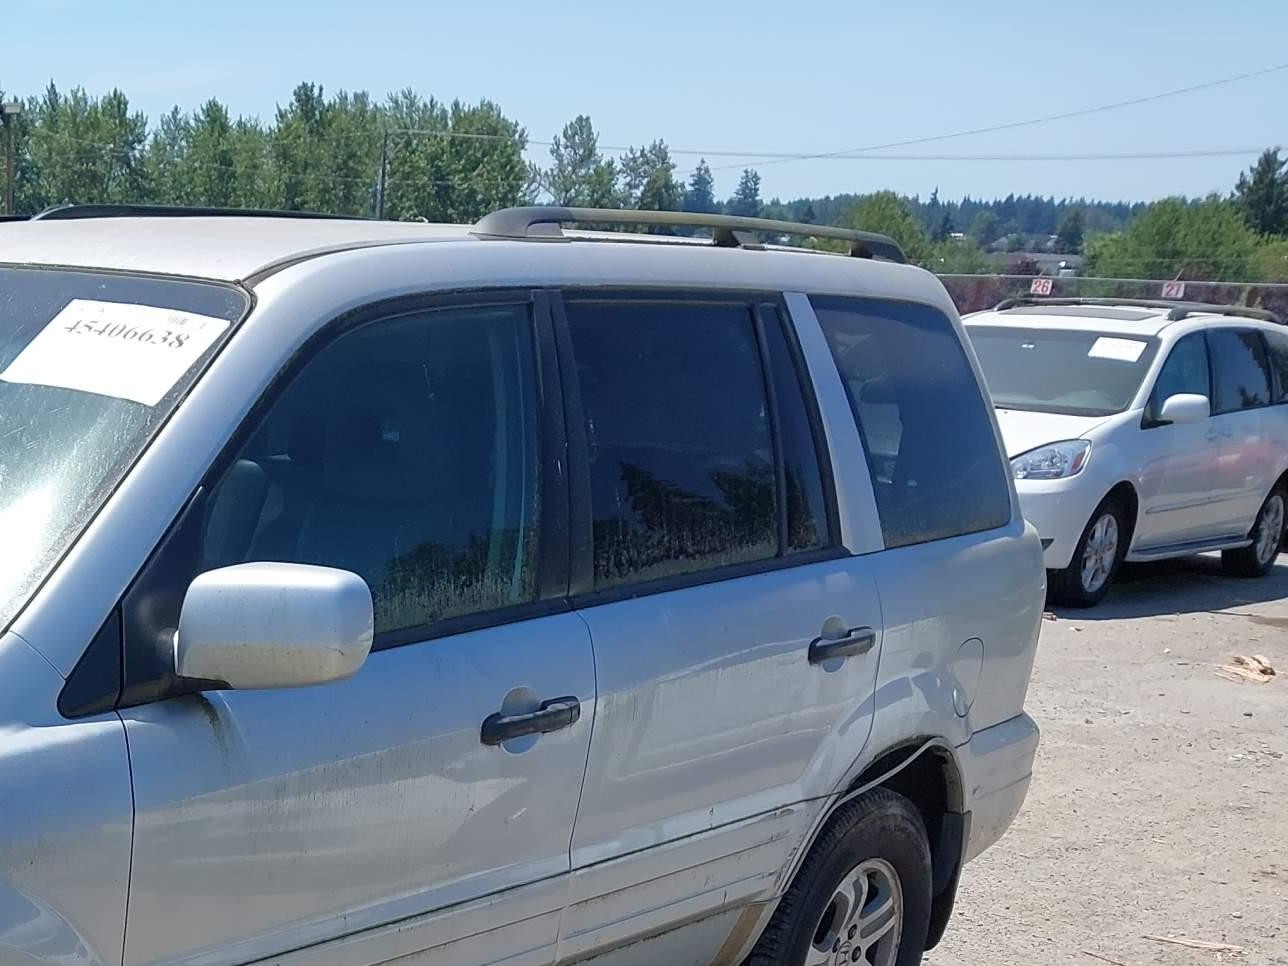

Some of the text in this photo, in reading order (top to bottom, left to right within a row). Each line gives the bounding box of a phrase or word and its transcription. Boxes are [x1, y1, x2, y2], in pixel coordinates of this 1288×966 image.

[1032, 280, 1049, 293] 26
[1165, 283, 1181, 296] 27
[63, 319, 191, 349] 45406638
